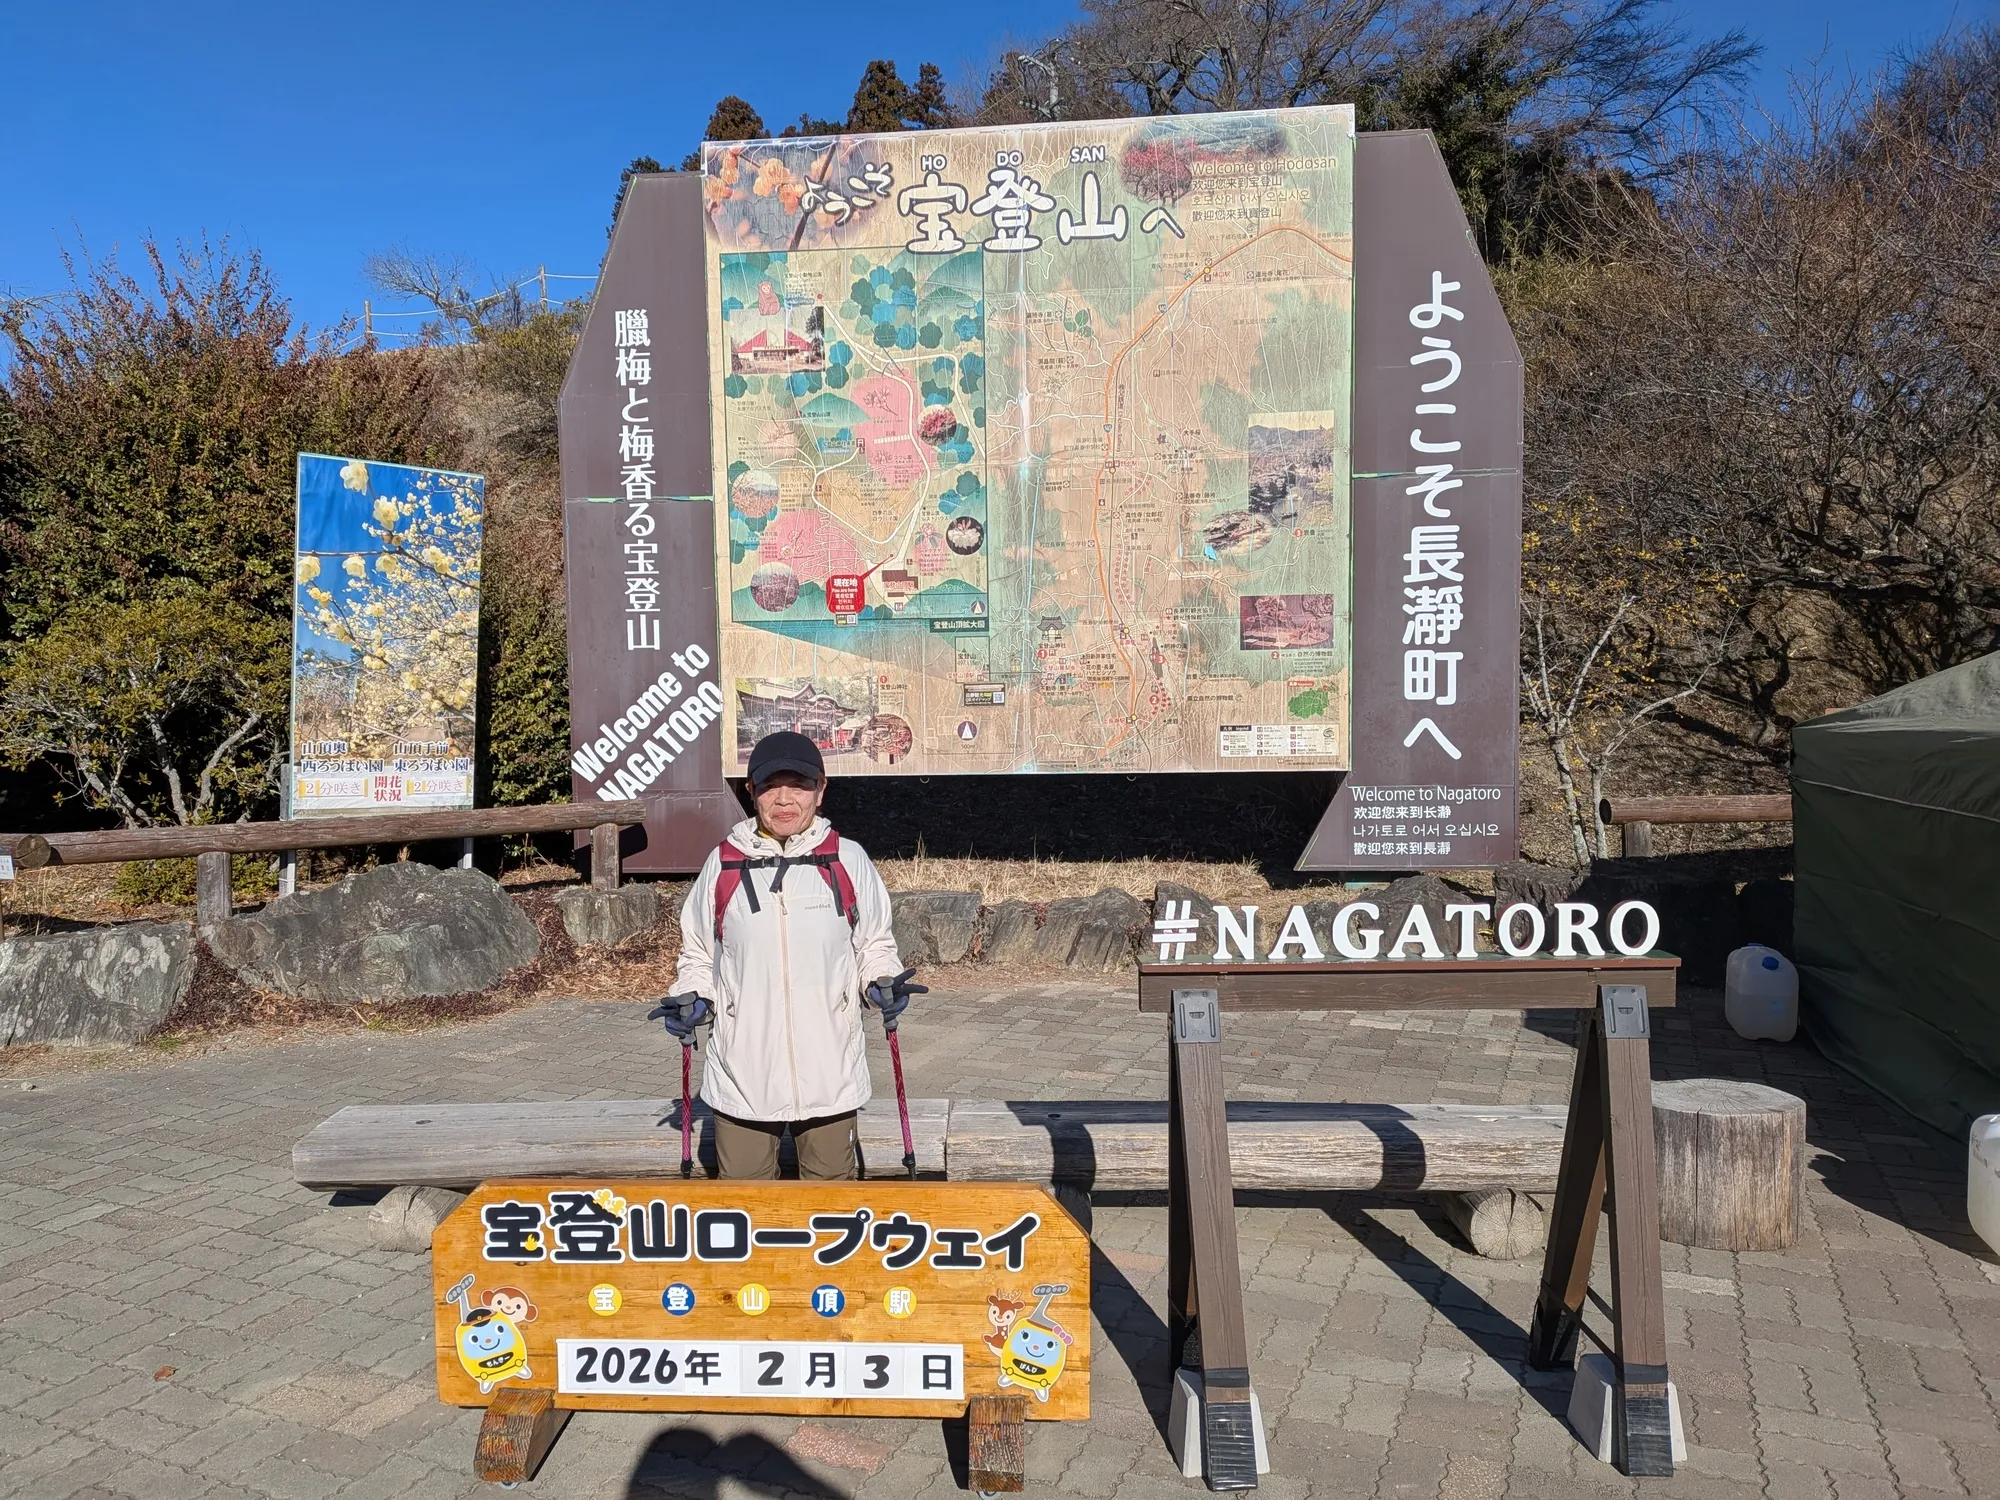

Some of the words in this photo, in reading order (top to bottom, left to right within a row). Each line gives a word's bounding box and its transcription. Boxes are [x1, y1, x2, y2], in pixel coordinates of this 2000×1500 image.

[922, 156, 946, 170] HO
[997, 151, 1022, 166] DO
[1071, 147, 1104, 163] SAN
[1192, 160, 1254, 175] Welcome
[1259, 160, 1272, 172] to
[1276, 157, 1336, 170] Hodosan
[801, 162, 894, 226] ようこそ
[1266, 190, 1310, 202] 오십시오
[614, 308, 661, 651] 臘梅と梅香る宝登山
[1402, 270, 1465, 760] ようこそ長瀞町へ
[833, 578, 858, 587] 現在地
[571, 671, 683, 783] Welcome
[670, 643, 710, 678] to
[302, 741, 347, 756] 山頂奥
[394, 741, 450, 756] 山頂手前
[596, 681, 723, 801] NAGATORO
[301, 759, 384, 773] 西ろうばい園
[394, 758, 470, 773] 東ろうばい園
[306, 782, 361, 796] 2分咲き
[374, 775, 402, 789] 開花
[414, 779, 464, 792] 2分咲き
[374, 789, 402, 802] 状況
[1352, 786, 1416, 802] Welcome
[1419, 788, 1434, 801] to
[1437, 785, 1501, 805] Nagatoro
[1354, 805, 1452, 820] 欢迎您来到长瀞
[1353, 824, 1408, 838] 나가토로
[1412, 824, 1440, 837] 어서
[1444, 823, 1500, 837] 오십시오
[1354, 841, 1451, 856] 歡迎您來到長瀞
[1152, 900, 1660, 961] #NAGATORO
[482, 1190, 1039, 1270] 宝登山ロープウェイ
